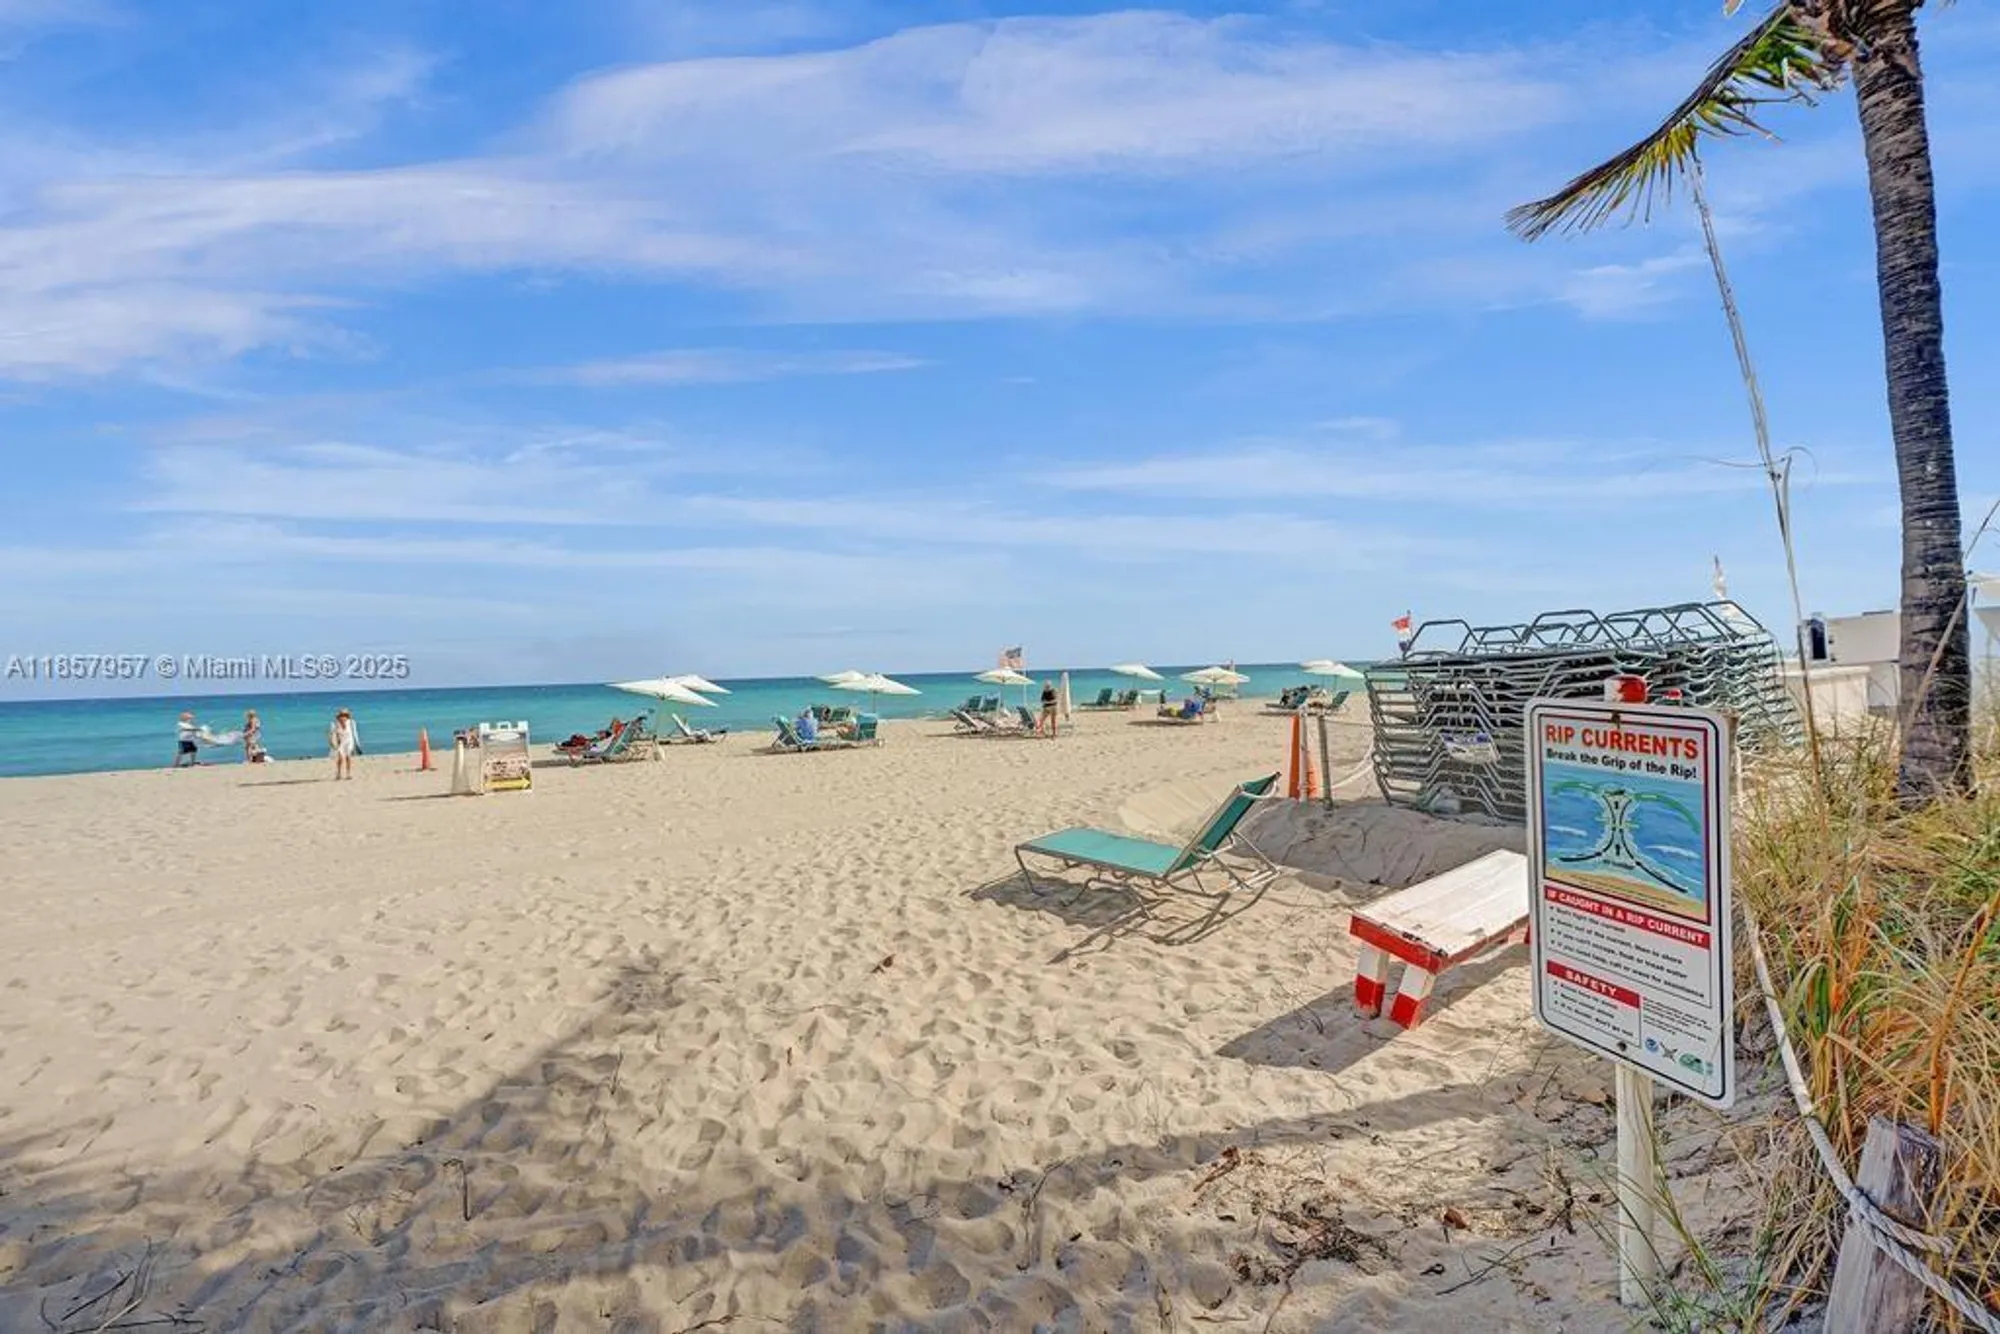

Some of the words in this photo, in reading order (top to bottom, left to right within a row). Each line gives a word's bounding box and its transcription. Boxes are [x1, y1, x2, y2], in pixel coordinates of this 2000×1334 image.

[1546, 725, 1575, 744] RIP
[1582, 729, 1698, 760] CURRENTS
[1547, 748, 1576, 761] Break
[1580, 752, 1599, 765] the
[1601, 755, 1626, 770] Grip
[1629, 760, 1641, 770] of
[1646, 761, 1667, 774] the
[1670, 763, 1697, 780] Rip!
[1559, 892, 1601, 913] CAUGHT
[1602, 903, 1613, 917] IN
[1615, 908, 1625, 920] A
[1626, 911, 1644, 925] RIP
[1647, 918, 1704, 944] CURRENT
[1565, 969, 1617, 996] SAFETY
